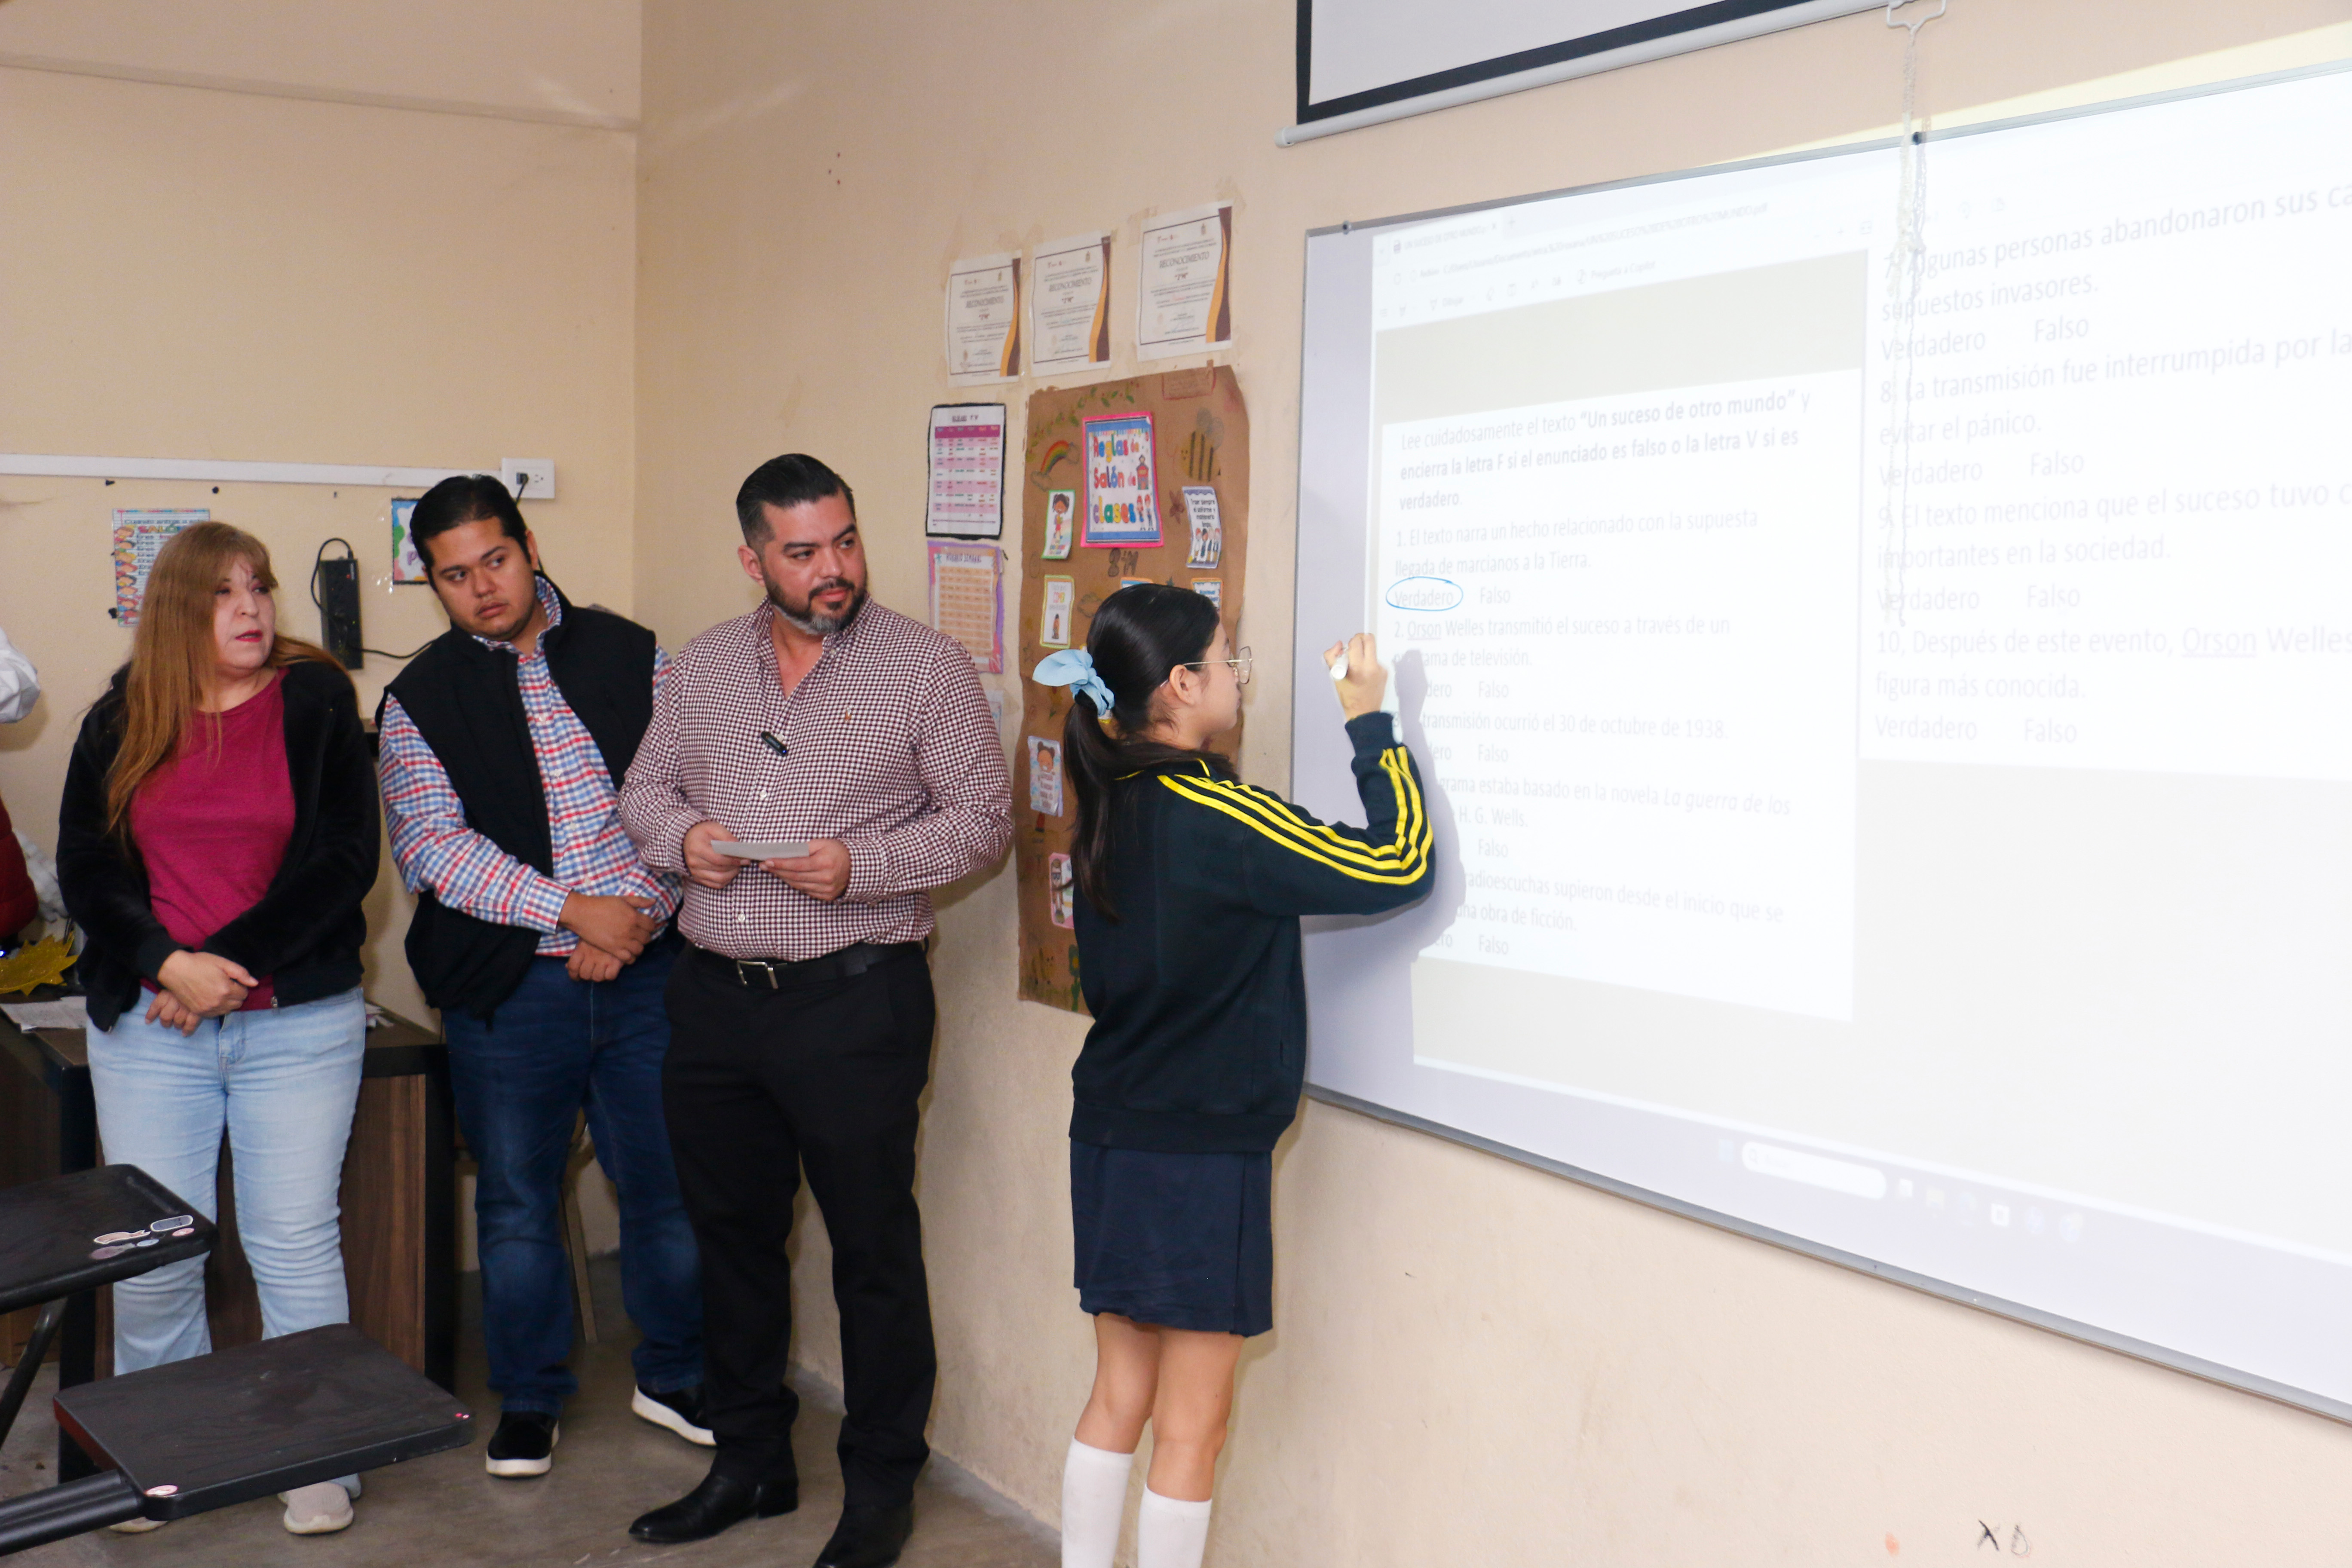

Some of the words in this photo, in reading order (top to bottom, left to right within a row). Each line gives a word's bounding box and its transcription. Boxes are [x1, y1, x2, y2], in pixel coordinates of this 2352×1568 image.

[1994, 229, 2093, 269] personas
[2100, 199, 2266, 246] abandonaron
[2275, 190, 2318, 217] sus
[1159, 251, 1210, 268] RECONOCIMIENTO
[1881, 287, 1984, 325] supuestos
[1991, 273, 2098, 307] invasores.
[1881, 326, 1986, 366] Verdadero
[2034, 314, 2089, 343] Falso
[1932, 362, 2055, 398] transmisión
[2062, 358, 2098, 384] fue
[2105, 337, 2265, 379] interrumpida
[2274, 337, 2321, 369] por
[1401, 434, 1421, 450] Lee
[1424, 420, 1524, 448] cuidadosamente
[1527, 416, 1539, 435] el
[1542, 414, 1576, 434] texto
[1611, 407, 1661, 426] suceso
[1665, 401, 1684, 421] de
[1689, 401, 1722, 419] otro
[1801, 393, 1810, 413] y
[1879, 412, 1936, 449] evitar
[1942, 414, 1960, 440] el
[1966, 409, 2042, 444] pánico.
[1093, 435, 1128, 462] Reglas
[1400, 461, 1448, 481] encierra
[1451, 458, 1462, 475] la
[1465, 456, 1494, 473] letra
[1497, 453, 1504, 471] F
[1507, 450, 1518, 470] si
[1520, 449, 1532, 468] el
[1536, 442, 1608, 466] enunciado
[1611, 444, 1627, 459] es
[1631, 438, 1667, 458] falso
[1671, 440, 1681, 455] o
[1686, 434, 1700, 453] la
[1704, 432, 1741, 452] letra
[1746, 429, 1758, 449] V
[1763, 427, 1775, 448] si
[1780, 430, 1799, 446] es
[1094, 466, 1124, 488] Salón
[1879, 456, 1983, 491] Verdadero
[2030, 450, 2085, 476] Falso
[1093, 496, 1136, 524] clases
[1400, 490, 1463, 510] verdadero.
[1926, 502, 1977, 527] texto
[1984, 496, 2089, 523] menciona
[2096, 496, 2139, 524] que
[2147, 487, 2167, 514] el
[2175, 488, 2260, 513] suceso
[2269, 482, 2330, 508] tuvo
[1397, 530, 1406, 547] 1.
[1409, 528, 1420, 546] El
[1423, 527, 1453, 545] texto
[1456, 527, 1488, 542] narra
[1491, 525, 1507, 540] un
[1510, 519, 1550, 539] hecho
[1553, 513, 1634, 537] relacionado
[1638, 516, 1665, 532] con
[1669, 511, 1682, 530] la
[1687, 508, 1758, 534] supuesta
[1395, 558, 1436, 579] llegada
[1438, 556, 1453, 575] de
[1457, 554, 1520, 573] marcianos
[1522, 556, 1531, 571] a
[1534, 551, 1545, 570] la
[1549, 550, 1591, 569] Tierra.
[1878, 536, 2000, 573] importantes
[2006, 545, 2032, 565] en
[2039, 538, 2056, 564] la
[2064, 533, 2171, 563] sociedad.
[1395, 587, 1454, 606] Verdadero
[1480, 586, 1511, 604] Falso
[1877, 583, 1980, 615] Verdadero
[2027, 583, 2081, 608] Falso
[1394, 620, 1404, 638] 2.
[1407, 620, 1442, 639] Orson
[1445, 618, 1485, 637] Welles
[1488, 616, 1553, 635] transmitió
[1556, 616, 1569, 635] el
[1571, 619, 1620, 635] suceso
[1623, 619, 1632, 635] a
[1636, 615, 1681, 634] través
[1686, 615, 1705, 634] de
[1710, 619, 1730, 634] un
[1452, 649, 1467, 667] de
[1470, 647, 1533, 666] televisión.
[1913, 628, 1997, 659] Después
[2004, 628, 2030, 653] de
[2037, 629, 2081, 653] este
[2089, 628, 2173, 657] evento,
[2181, 627, 2257, 659] Orson
[1479, 680, 1510, 699] Falso
[1875, 671, 1930, 702] figura
[1938, 672, 1979, 697] más
[1985, 672, 2086, 698] conocida.
[1421, 712, 1491, 730] transmisión
[1494, 712, 1540, 732] ocurrió
[1543, 713, 1555, 732] el
[1559, 714, 1576, 733] 30
[1579, 714, 1596, 733] de
[1600, 716, 1657, 736] octubre
[1661, 717, 1680, 737] de
[1686, 719, 1729, 739] 1938.
[1874, 714, 1978, 741] Verdadero
[2024, 717, 2078, 744] Falso
[1478, 743, 1510, 763] Falso
[1481, 776, 1520, 796] estaba
[1523, 777, 1570, 799] basado
[1574, 784, 1591, 800] en
[1595, 782, 1607, 801] la
[1611, 784, 1659, 805] novela
[1663, 787, 1681, 807] La
[1684, 793, 1738, 813] guerra
[1743, 793, 1763, 814] de
[1767, 794, 1791, 816] los
[1475, 805, 1488, 825] G.
[1491, 808, 1529, 828] Wells.
[1479, 838, 1510, 862] Falso
[1553, 879, 1613, 902] supieron
[1617, 884, 1661, 908] desde
[1665, 890, 1679, 910] el
[1683, 891, 1725, 916] inicio
[1730, 901, 1761, 923] que
[1765, 905, 1784, 923] se
[1482, 904, 1508, 923] obra
[1511, 906, 1527, 925] de
[1530, 906, 1577, 931] ficción.
[1479, 934, 1510, 956] Falso
